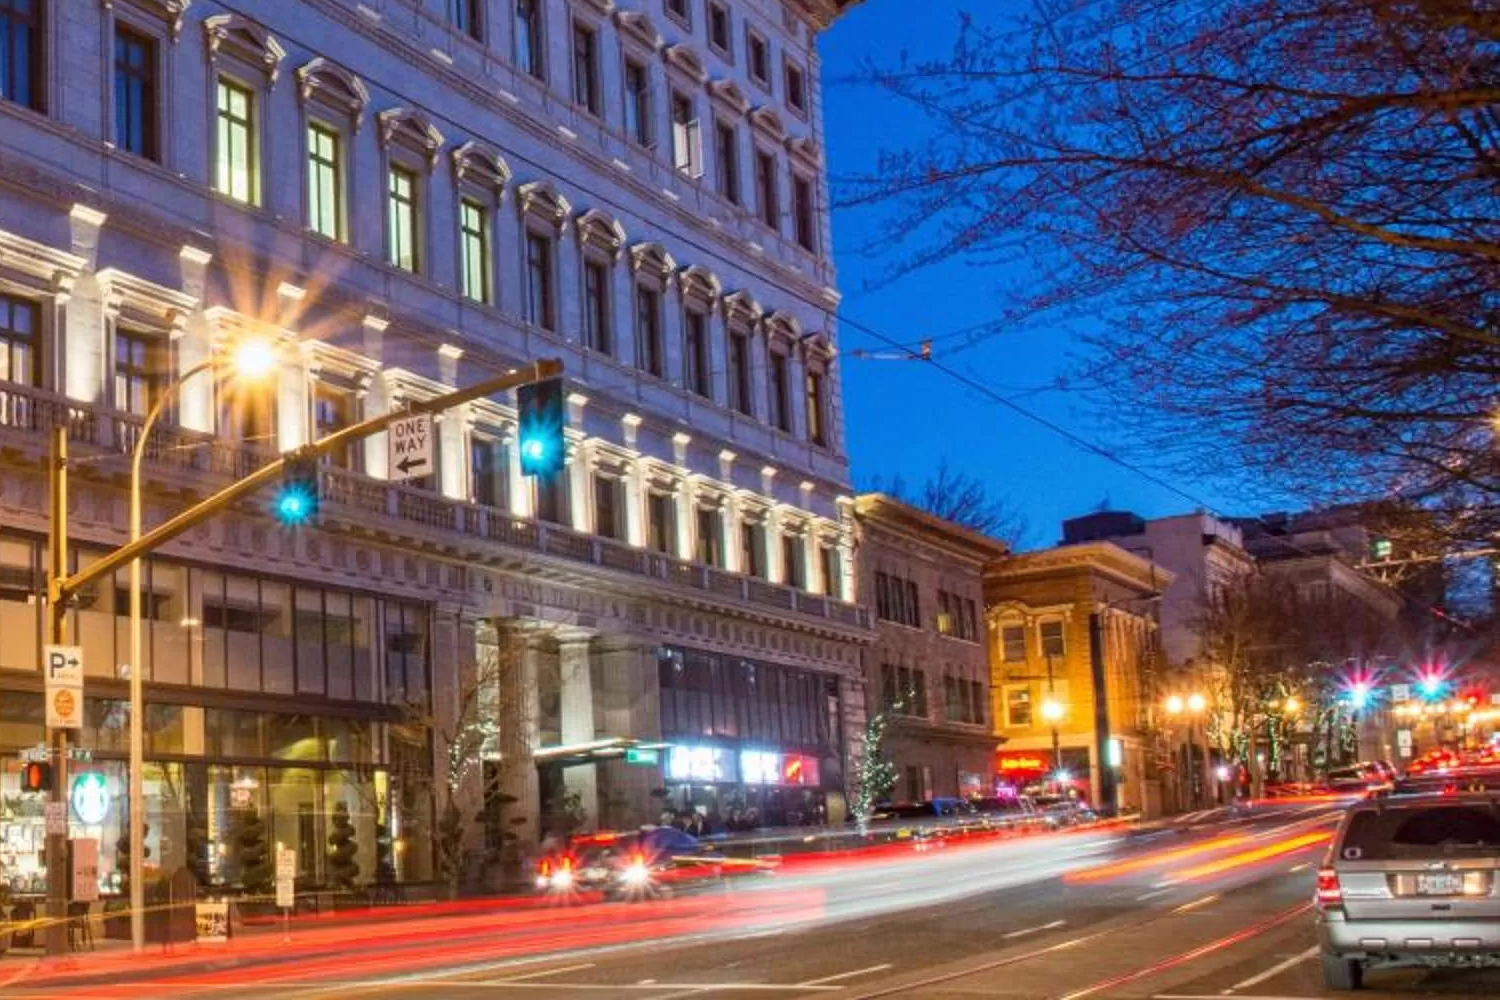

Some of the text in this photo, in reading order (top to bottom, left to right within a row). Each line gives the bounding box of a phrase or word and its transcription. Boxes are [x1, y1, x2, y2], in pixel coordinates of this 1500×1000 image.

[396, 418, 425, 437] ONE
[396, 435, 426, 453] WAY
[50, 653, 65, 678] P
